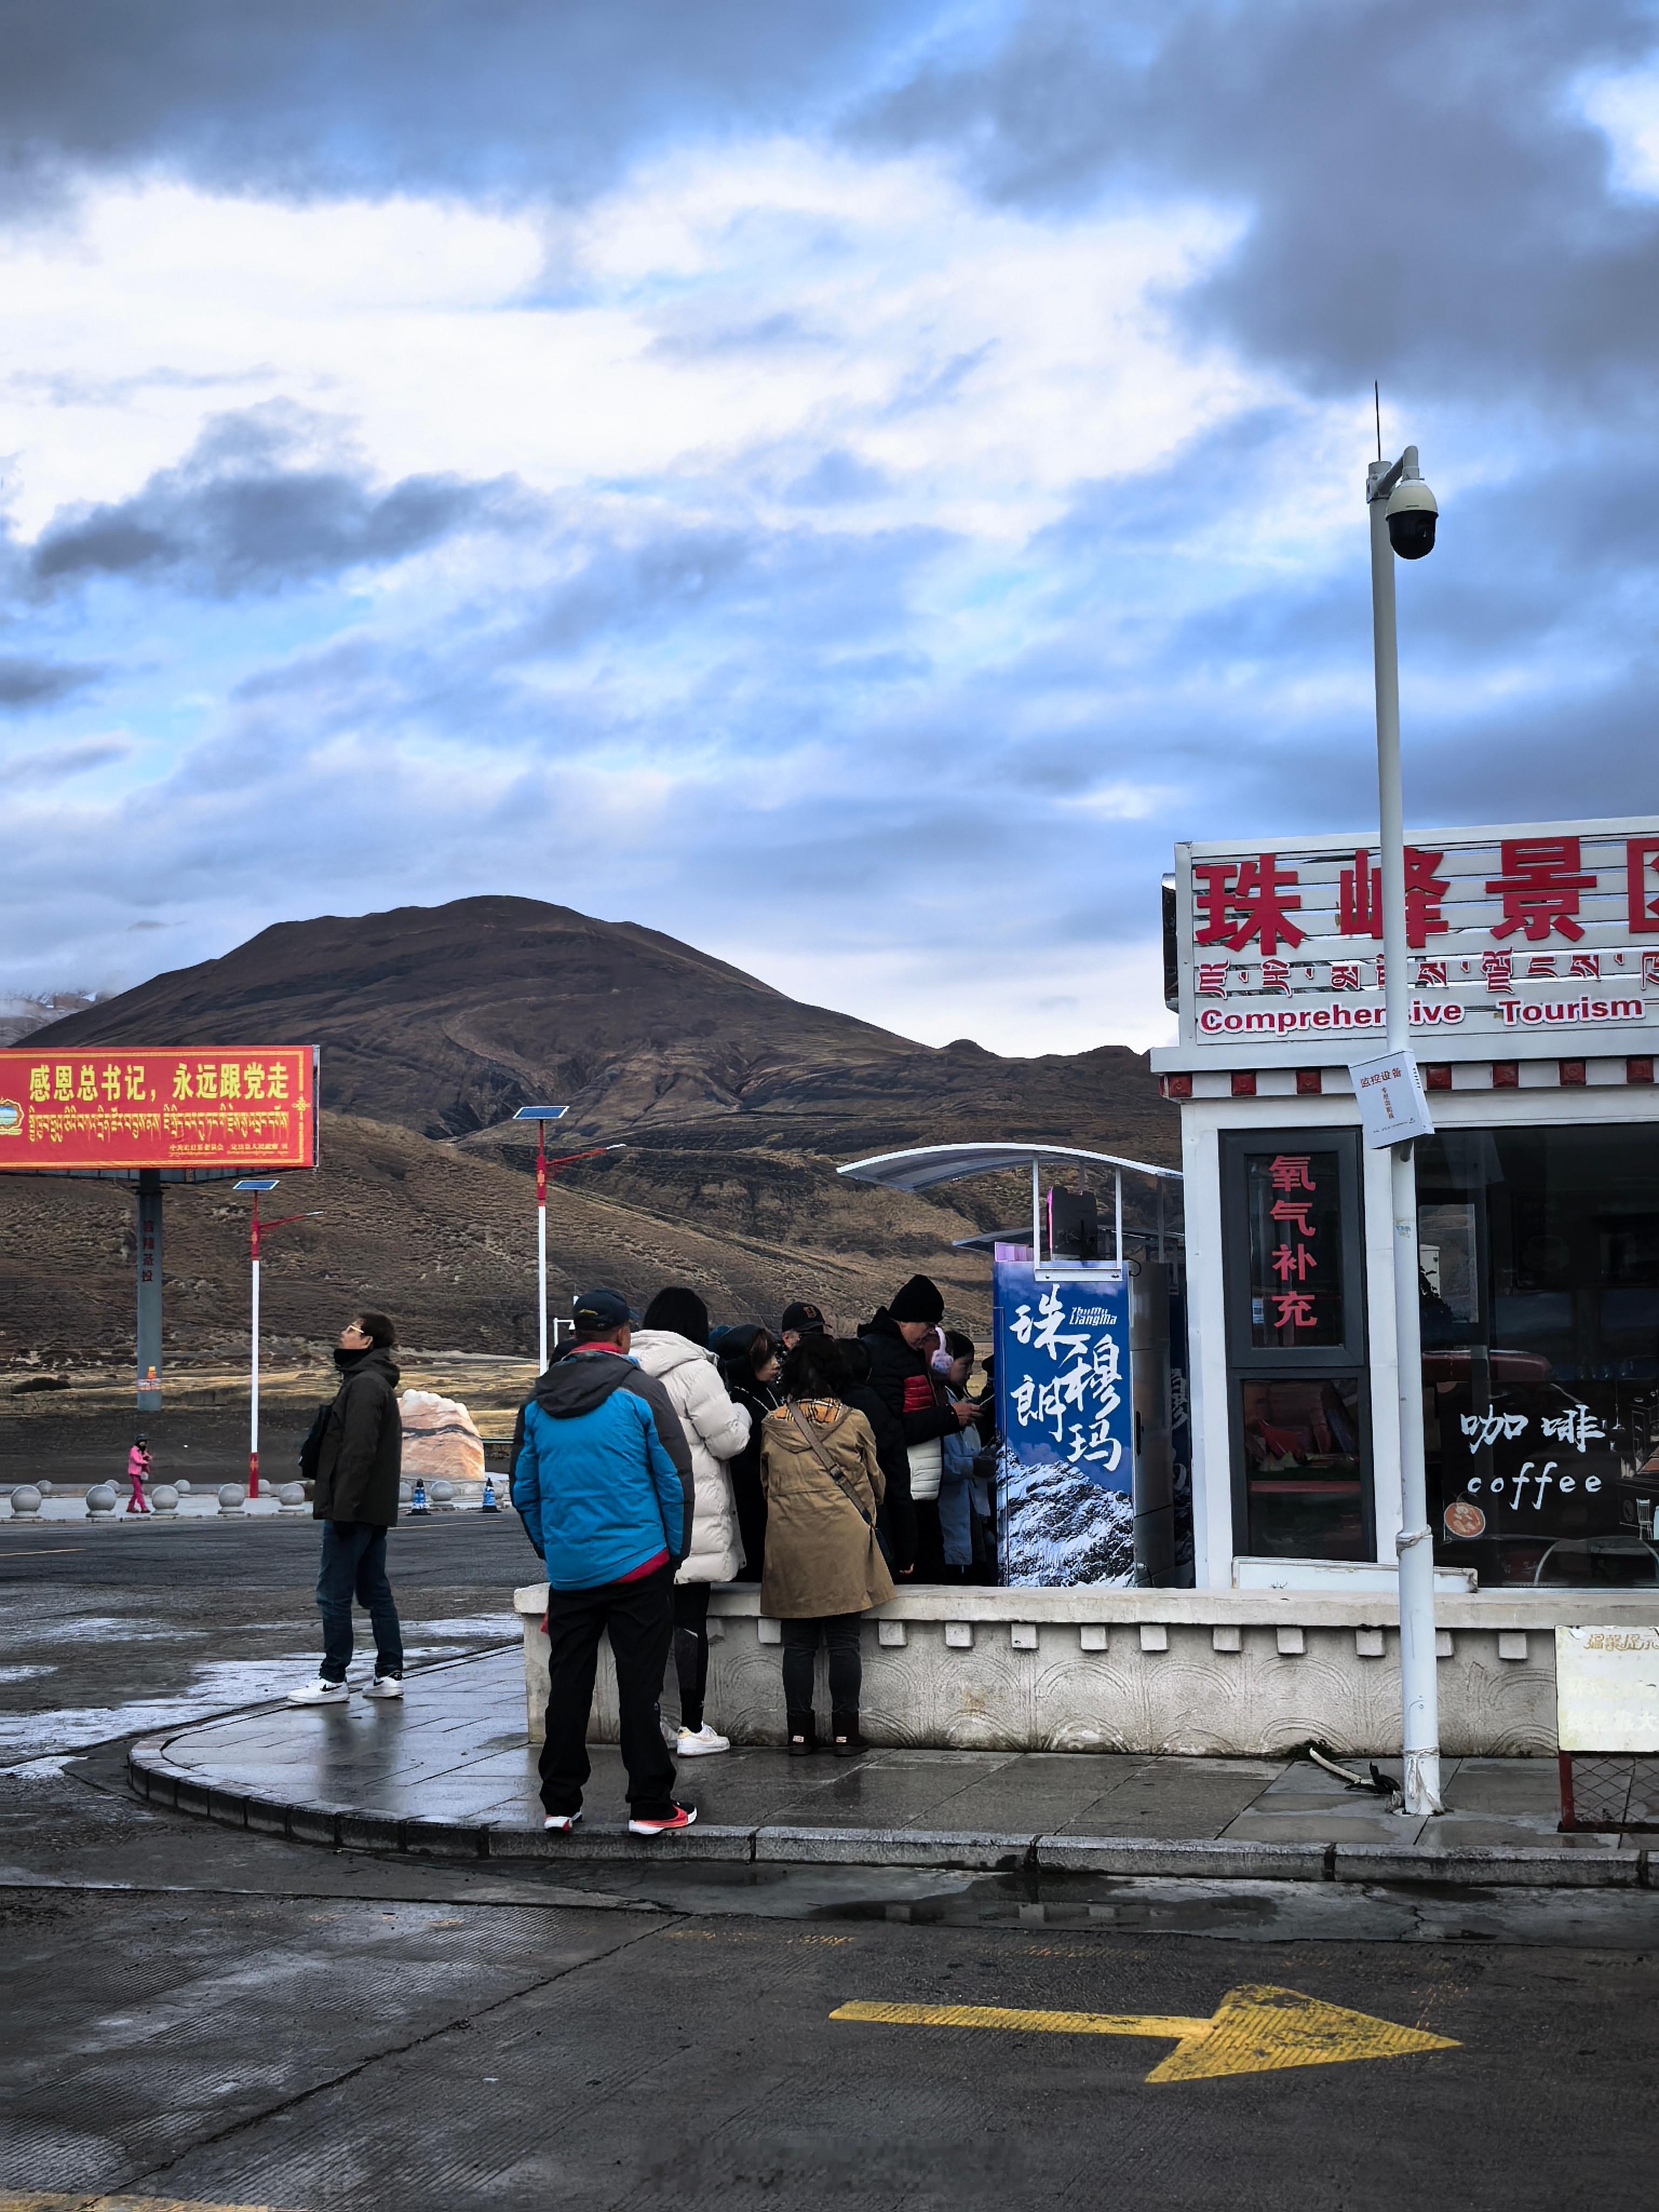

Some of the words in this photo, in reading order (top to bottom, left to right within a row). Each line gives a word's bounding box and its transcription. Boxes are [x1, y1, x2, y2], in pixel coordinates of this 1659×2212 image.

[1200, 999, 1462, 1033] Comprehenive
[1498, 995, 1643, 1023] Tourism
[29, 1063, 157, 1102] 感恩总书记，
[172, 1062, 288, 1100] 永远跟党走
[1269, 1156, 1317, 1328] 氧气补充
[1460, 1404, 1606, 1454] 咖啡
[1467, 1461, 1602, 1510] coffee
